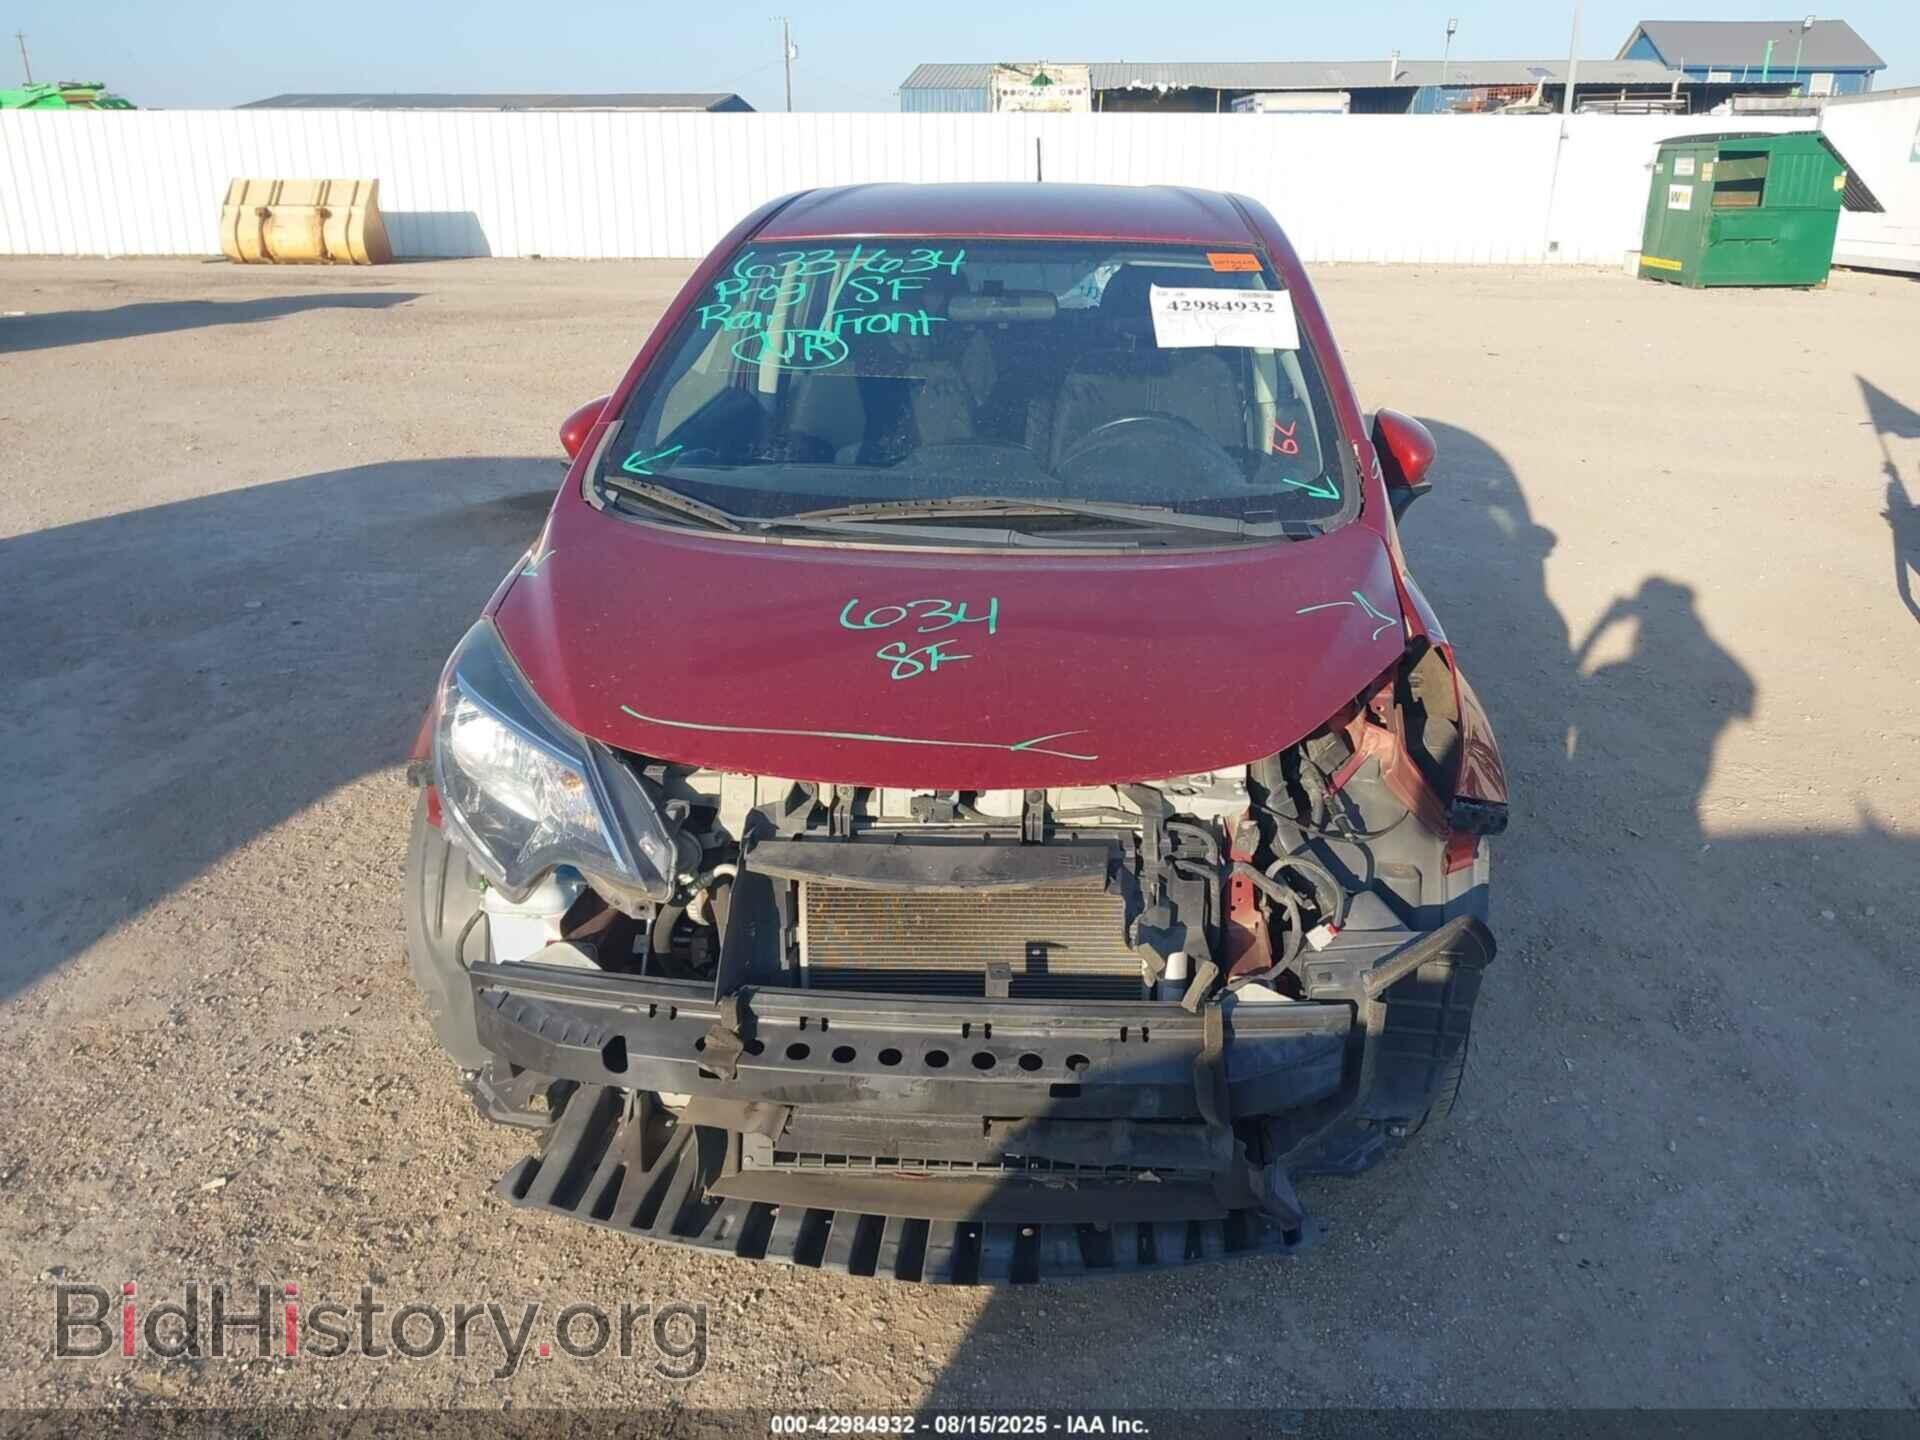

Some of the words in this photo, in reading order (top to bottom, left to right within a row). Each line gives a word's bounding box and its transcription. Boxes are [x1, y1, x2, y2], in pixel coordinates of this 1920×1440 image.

[848, 276, 931, 303] SF
[1166, 300, 1275, 313] 42984932
[832, 308, 948, 336] Front
